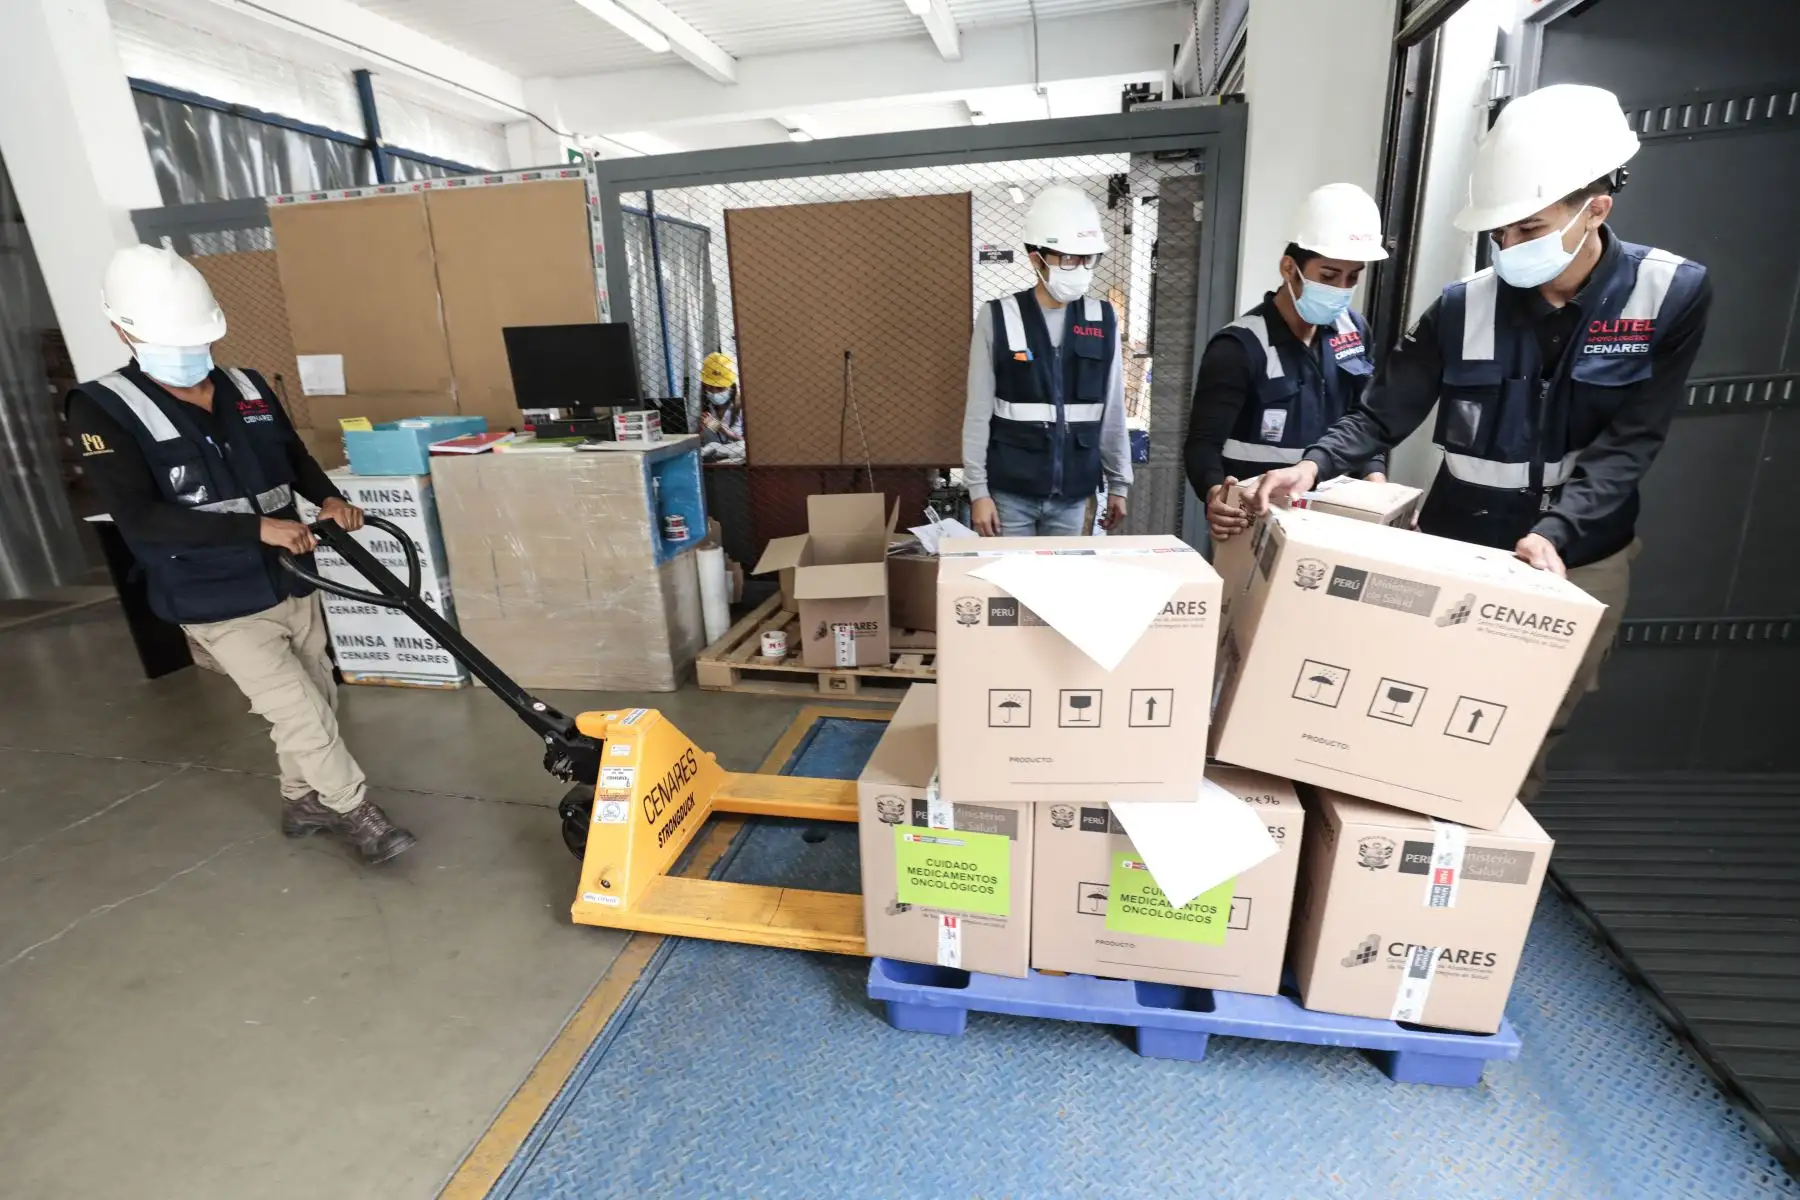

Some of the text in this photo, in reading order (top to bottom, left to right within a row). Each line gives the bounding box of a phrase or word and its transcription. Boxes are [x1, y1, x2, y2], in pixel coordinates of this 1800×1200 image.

[1073, 325, 1104, 338] OLITEL
[1588, 319, 1656, 333] OLITEL
[1583, 343, 1650, 354] CENARES
[358, 489, 414, 503] MINSA
[369, 540, 424, 553] MINA
[1333, 577, 1361, 590] PERÚ
[328, 605, 379, 615] CENARES
[991, 606, 1015, 617] PERÚ
[1158, 601, 1207, 615] ARES
[830, 621, 878, 632] CARES
[1480, 603, 1577, 636] CENARES
[336, 634, 386, 648] MINSA
[340, 651, 449, 664] CENARES CENARES
[643, 747, 698, 825] CENARES
[915, 810, 929, 820] PE
[1083, 816, 1105, 825] PERÚ
[926, 857, 978, 872] CUIDADO
[1405, 853, 1431, 865] PER
[1466, 851, 1517, 865] nisterio
[907, 866, 998, 885] MEDICAMENTOS
[911, 877, 995, 895] ONCOLÓGICOS
[1119, 893, 1217, 914] MEDICANTOS
[1388, 942, 1497, 967] CARES
